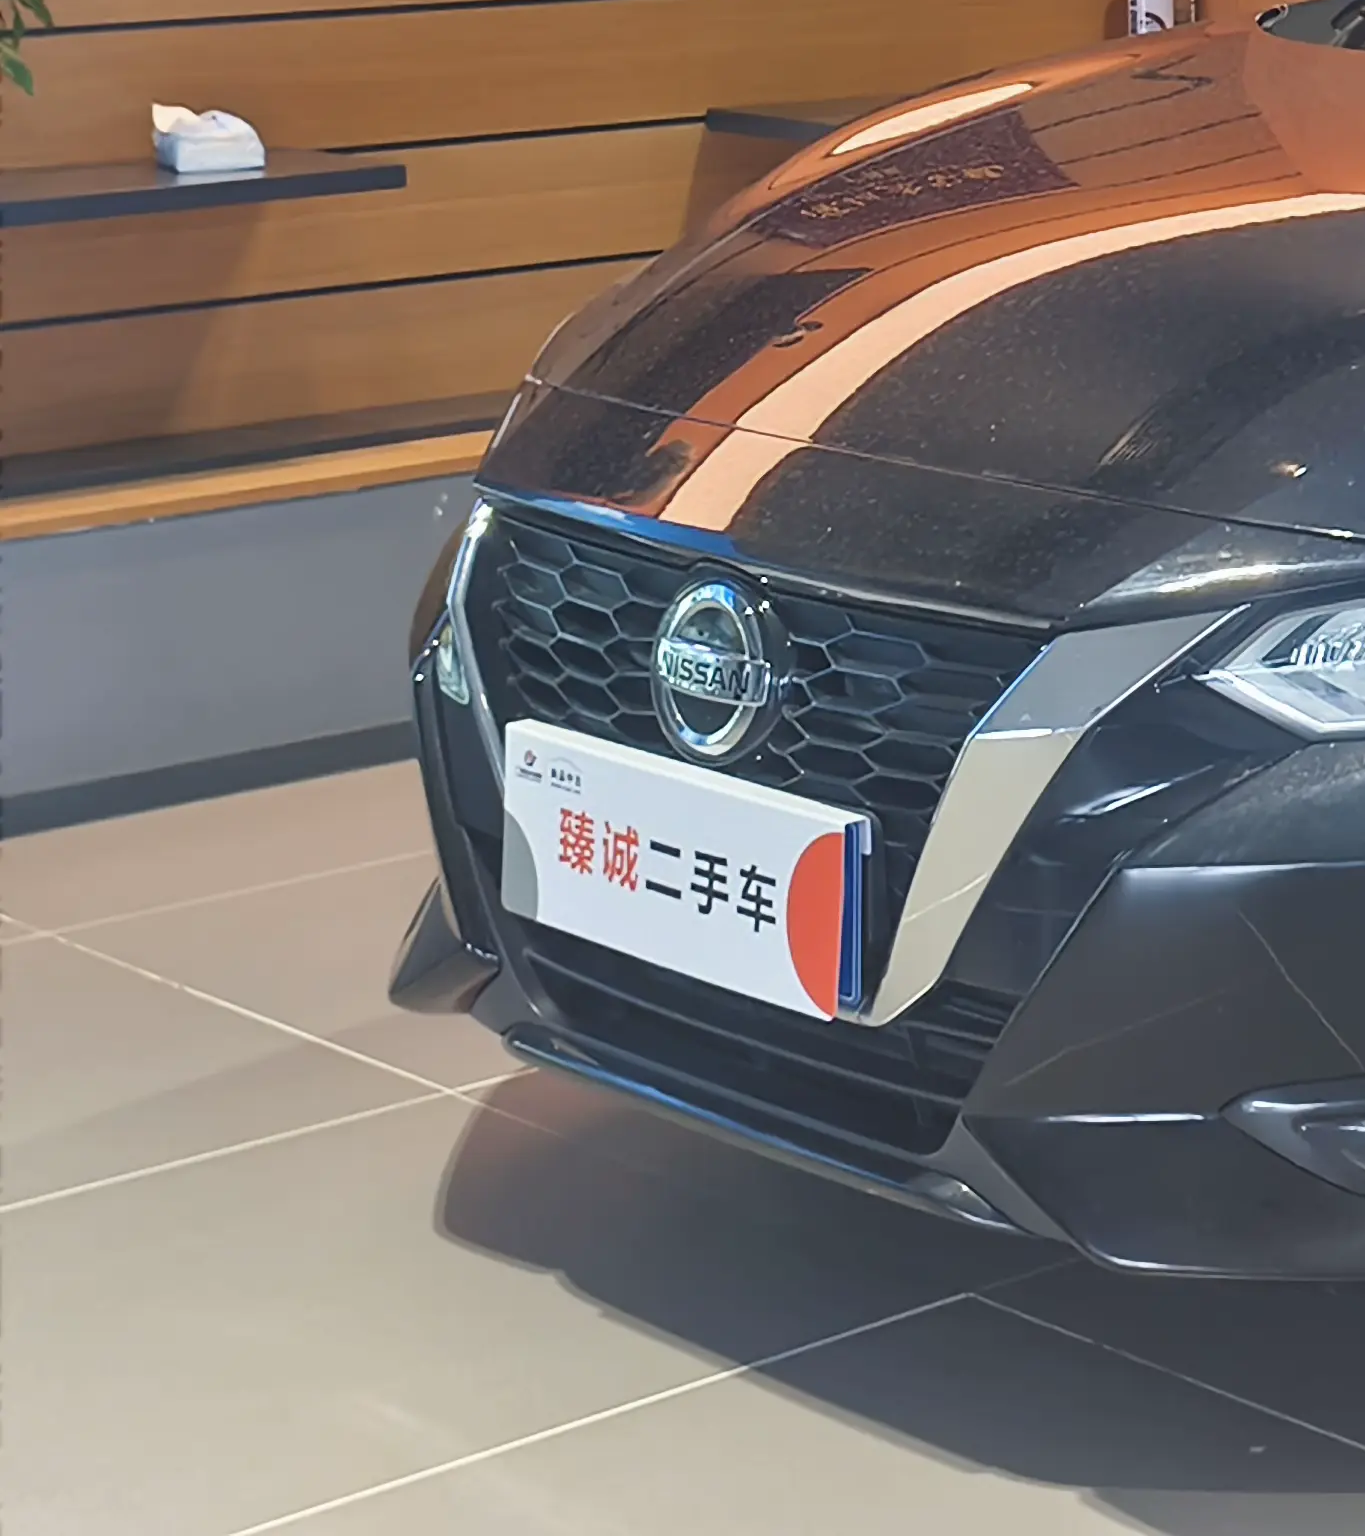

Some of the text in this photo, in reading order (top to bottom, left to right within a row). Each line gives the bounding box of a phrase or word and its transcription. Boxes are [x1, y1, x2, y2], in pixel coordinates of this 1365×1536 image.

[662, 650, 751, 694] NISSAN
[559, 807, 777, 933] 臻诚二手车
